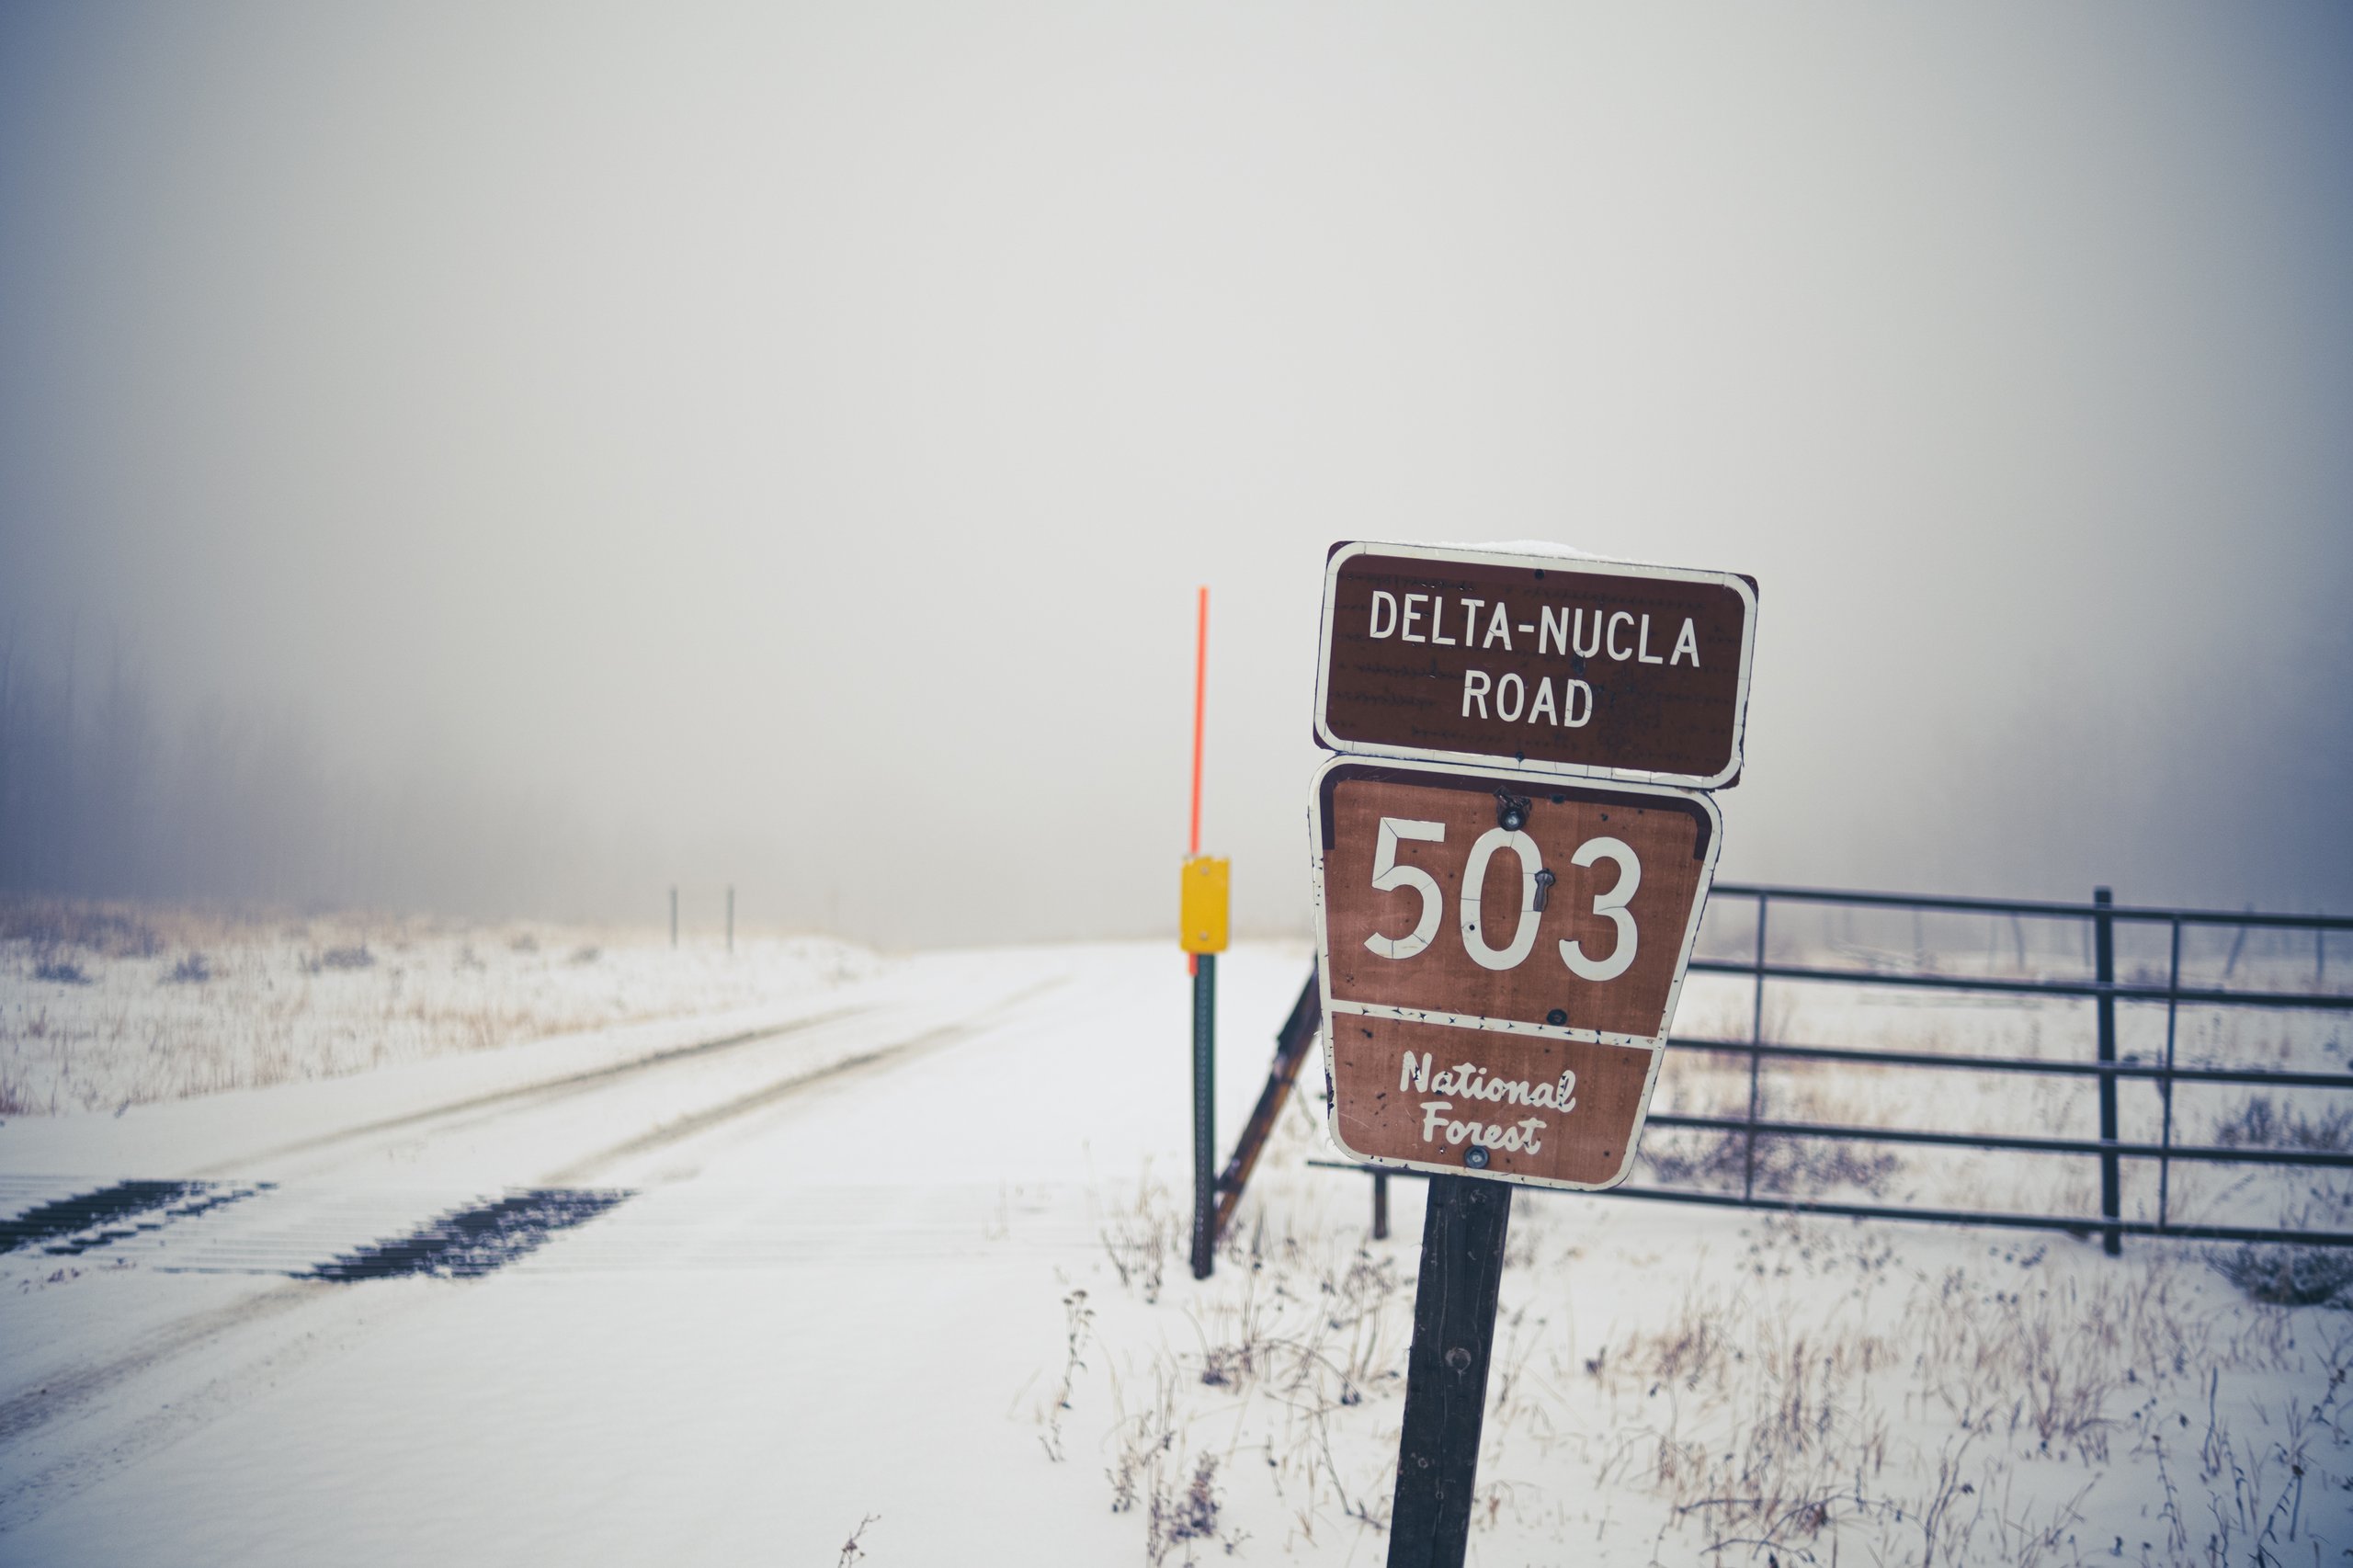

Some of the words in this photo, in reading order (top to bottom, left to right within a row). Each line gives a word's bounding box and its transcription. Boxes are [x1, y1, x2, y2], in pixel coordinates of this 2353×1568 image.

[1369, 589, 1701, 668] DELTA-NUCLA
[1461, 669, 1594, 729] ROAD
[1362, 815, 1643, 983] 503
[1398, 1049, 1577, 1114] National
[1418, 1100, 1548, 1156] Forest
